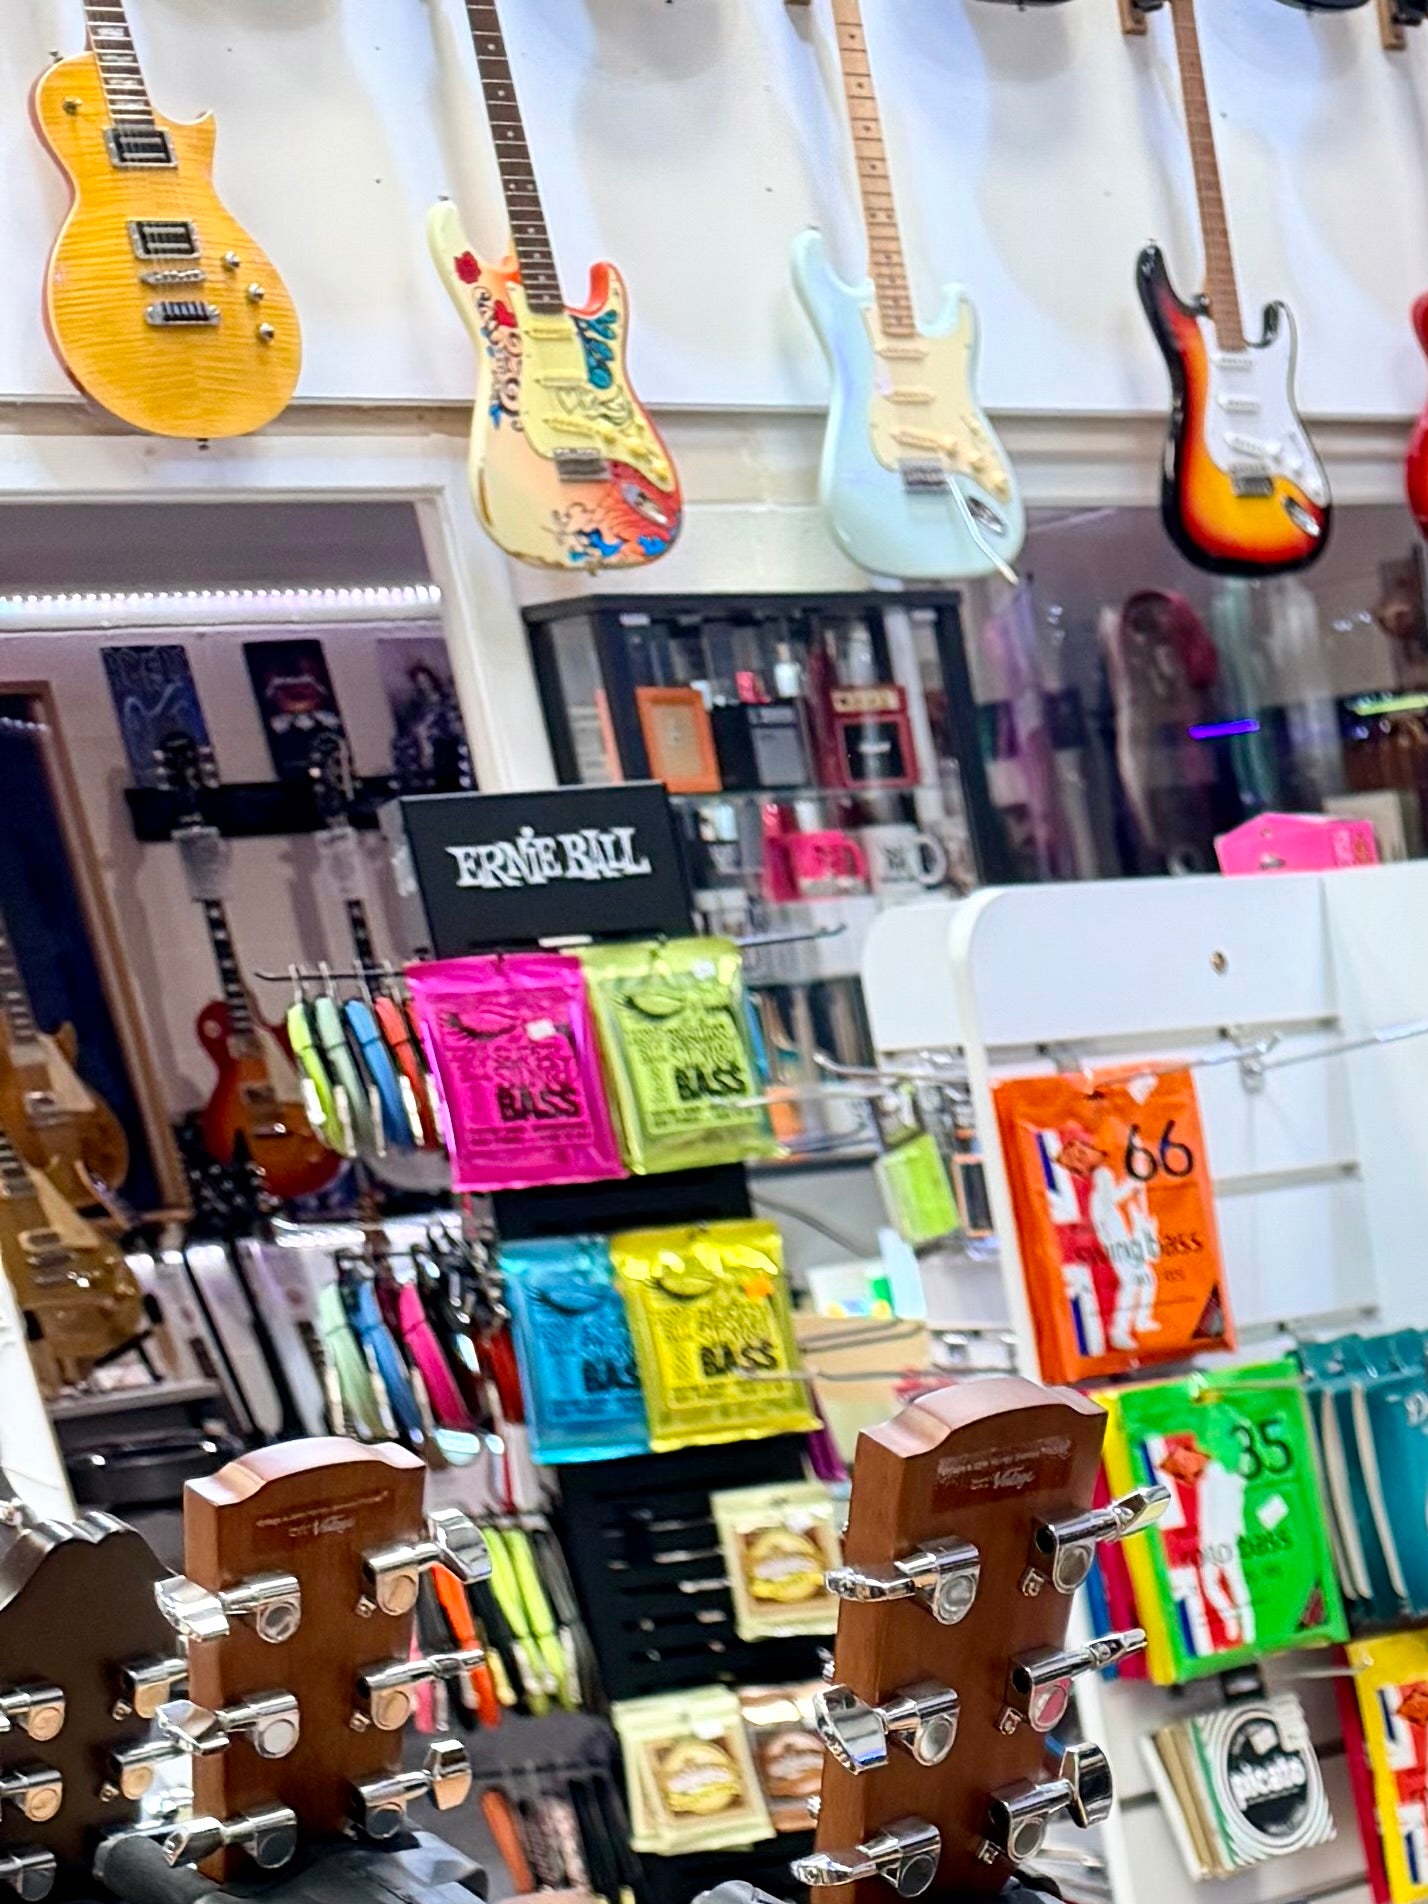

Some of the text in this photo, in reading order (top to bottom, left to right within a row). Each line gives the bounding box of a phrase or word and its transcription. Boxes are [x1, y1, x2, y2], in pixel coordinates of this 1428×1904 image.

[445, 826, 653, 888] ERNIE BALL
[674, 1060, 747, 1101] BASS
[498, 1082, 581, 1122] BASS
[1125, 1120, 1195, 1182] 66
[582, 1357, 640, 1393] BAS
[700, 1341, 779, 1377] BASS
[1227, 1418, 1293, 1480] 35
